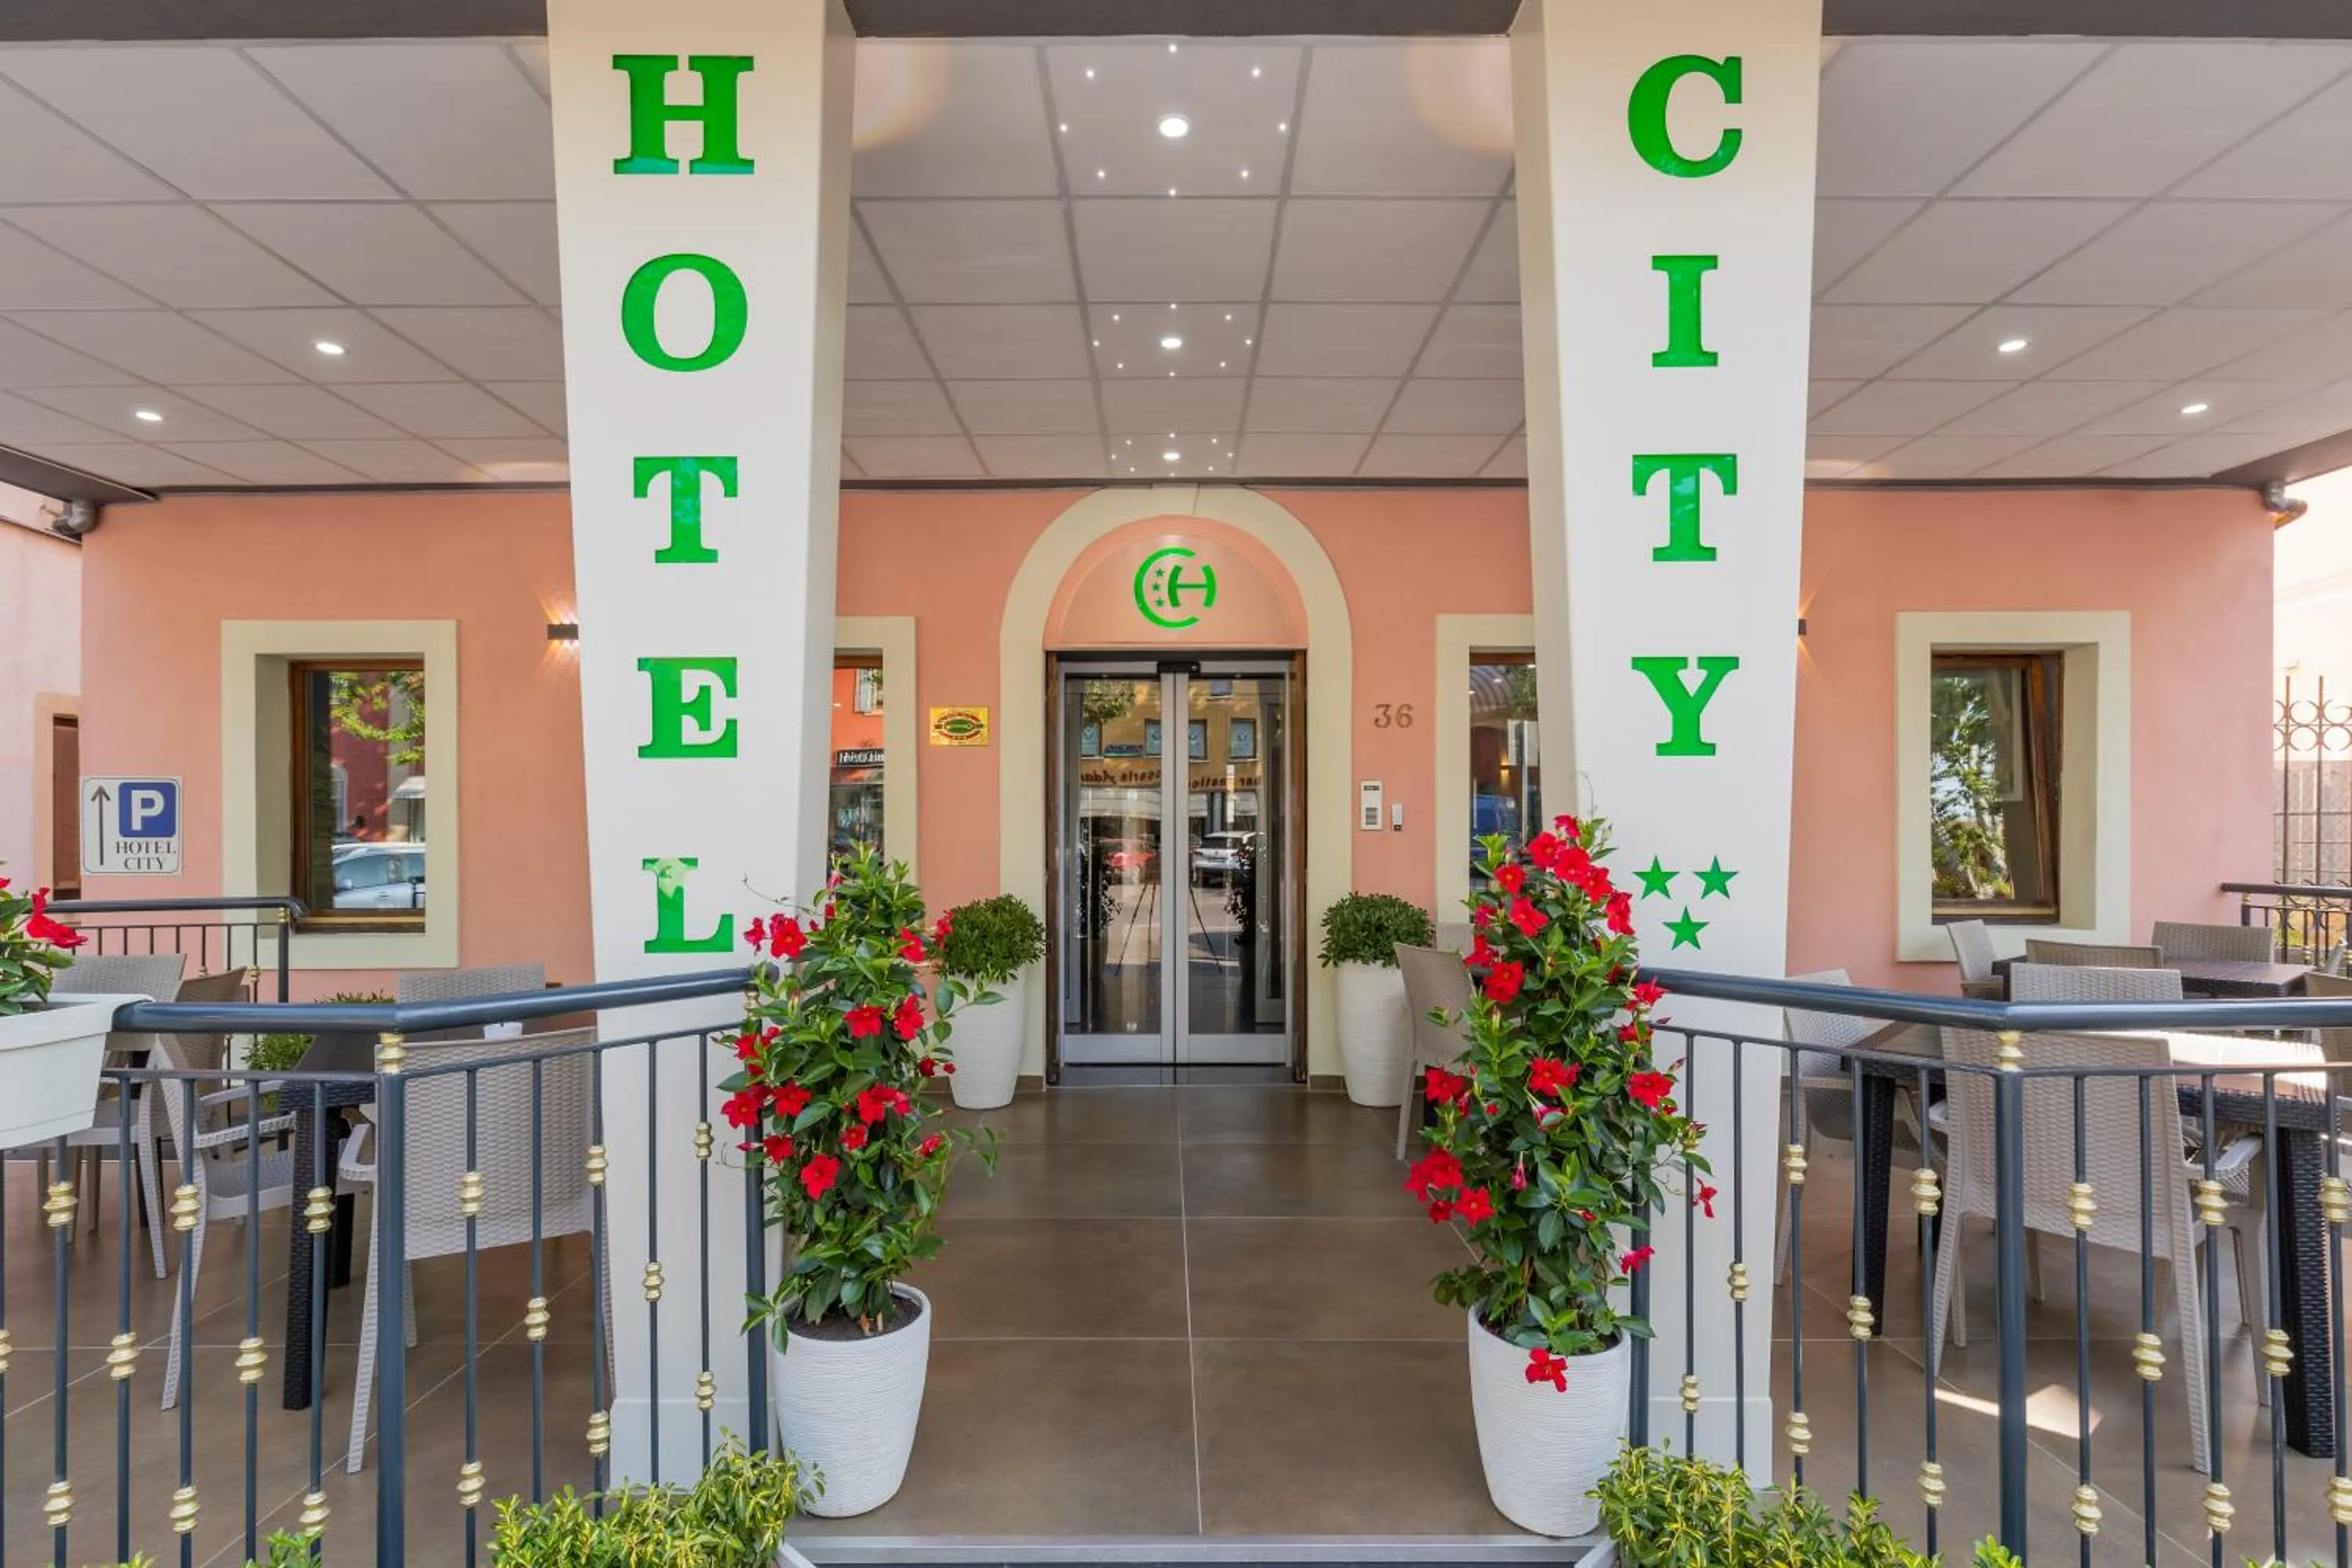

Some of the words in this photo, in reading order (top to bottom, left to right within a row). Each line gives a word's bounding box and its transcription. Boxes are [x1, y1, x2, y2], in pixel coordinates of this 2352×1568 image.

[1627, 54, 1744, 757] CITY
[611, 54, 755, 954] HOTEL
[1374, 704, 1414, 728] 36
[132, 789, 165, 830] P
[116, 841, 176, 854] HOTEL
[124, 857, 165, 870] CITY
